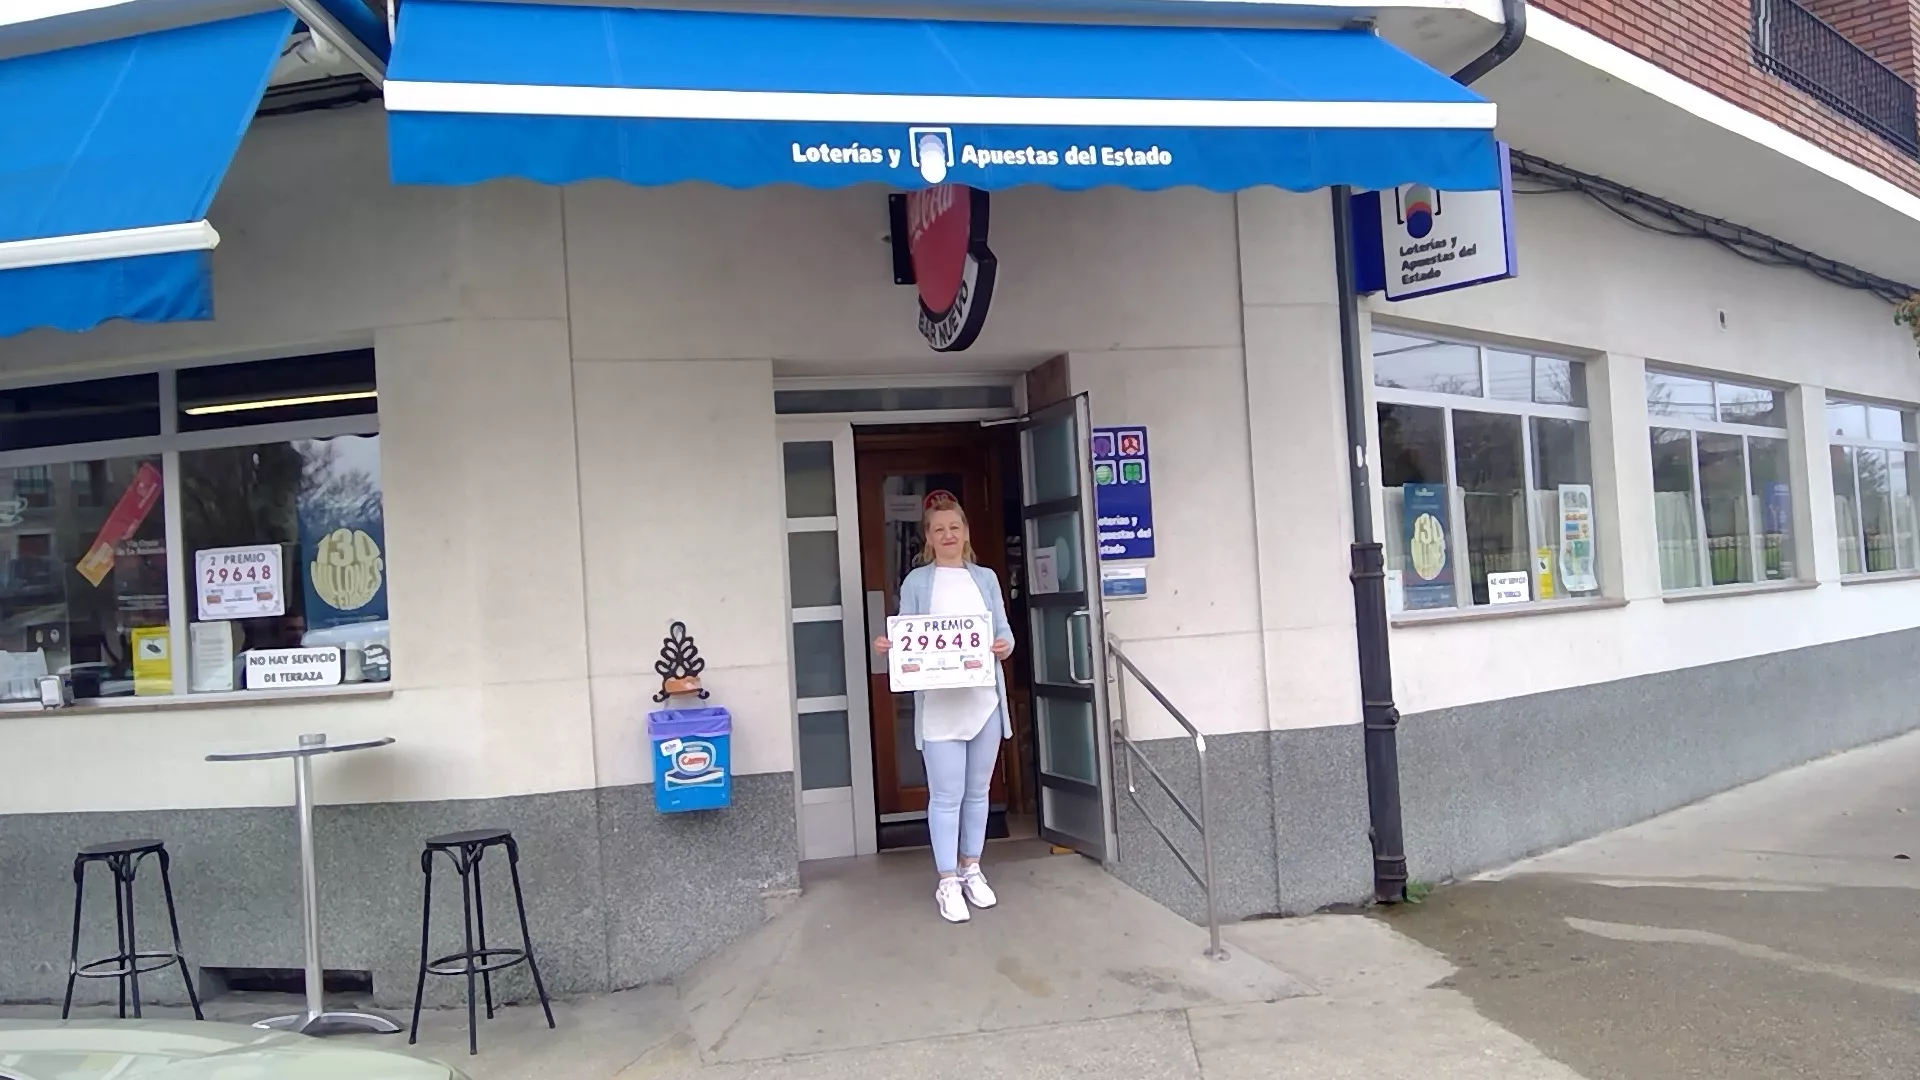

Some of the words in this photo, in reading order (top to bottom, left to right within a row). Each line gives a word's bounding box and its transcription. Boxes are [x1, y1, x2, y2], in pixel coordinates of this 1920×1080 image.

[791, 142, 883, 164] Loterías
[887, 148, 901, 169] y
[961, 144, 1059, 167] Apuestas
[1065, 143, 1097, 166] del
[1101, 146, 1172, 167] Estado
[1400, 237, 1447, 257] Loterías
[1451, 236, 1458, 249] y
[1401, 251, 1456, 271] Apuestas
[1459, 243, 1477, 258] del
[1401, 268, 1442, 285] Estado
[938, 280, 969, 347] NUEVO
[1098, 515, 1130, 526] oterías
[1099, 530, 1136, 542] puestas
[317, 528, 381, 566] 130
[1100, 544, 1127, 555] stado
[209, 556, 216, 566] 2
[223, 552, 266, 565] PREMIO
[206, 565, 271, 584] 29648
[905, 622, 914, 632] 2
[924, 619, 974, 632] PREMIO
[900, 632, 981, 652] 29648
[249, 656, 266, 666] NO
[268, 655, 289, 665] HAY
[291, 652, 337, 665] SERVICIO
[263, 673, 276, 683] DE
[279, 671, 323, 682] TERRAZA
